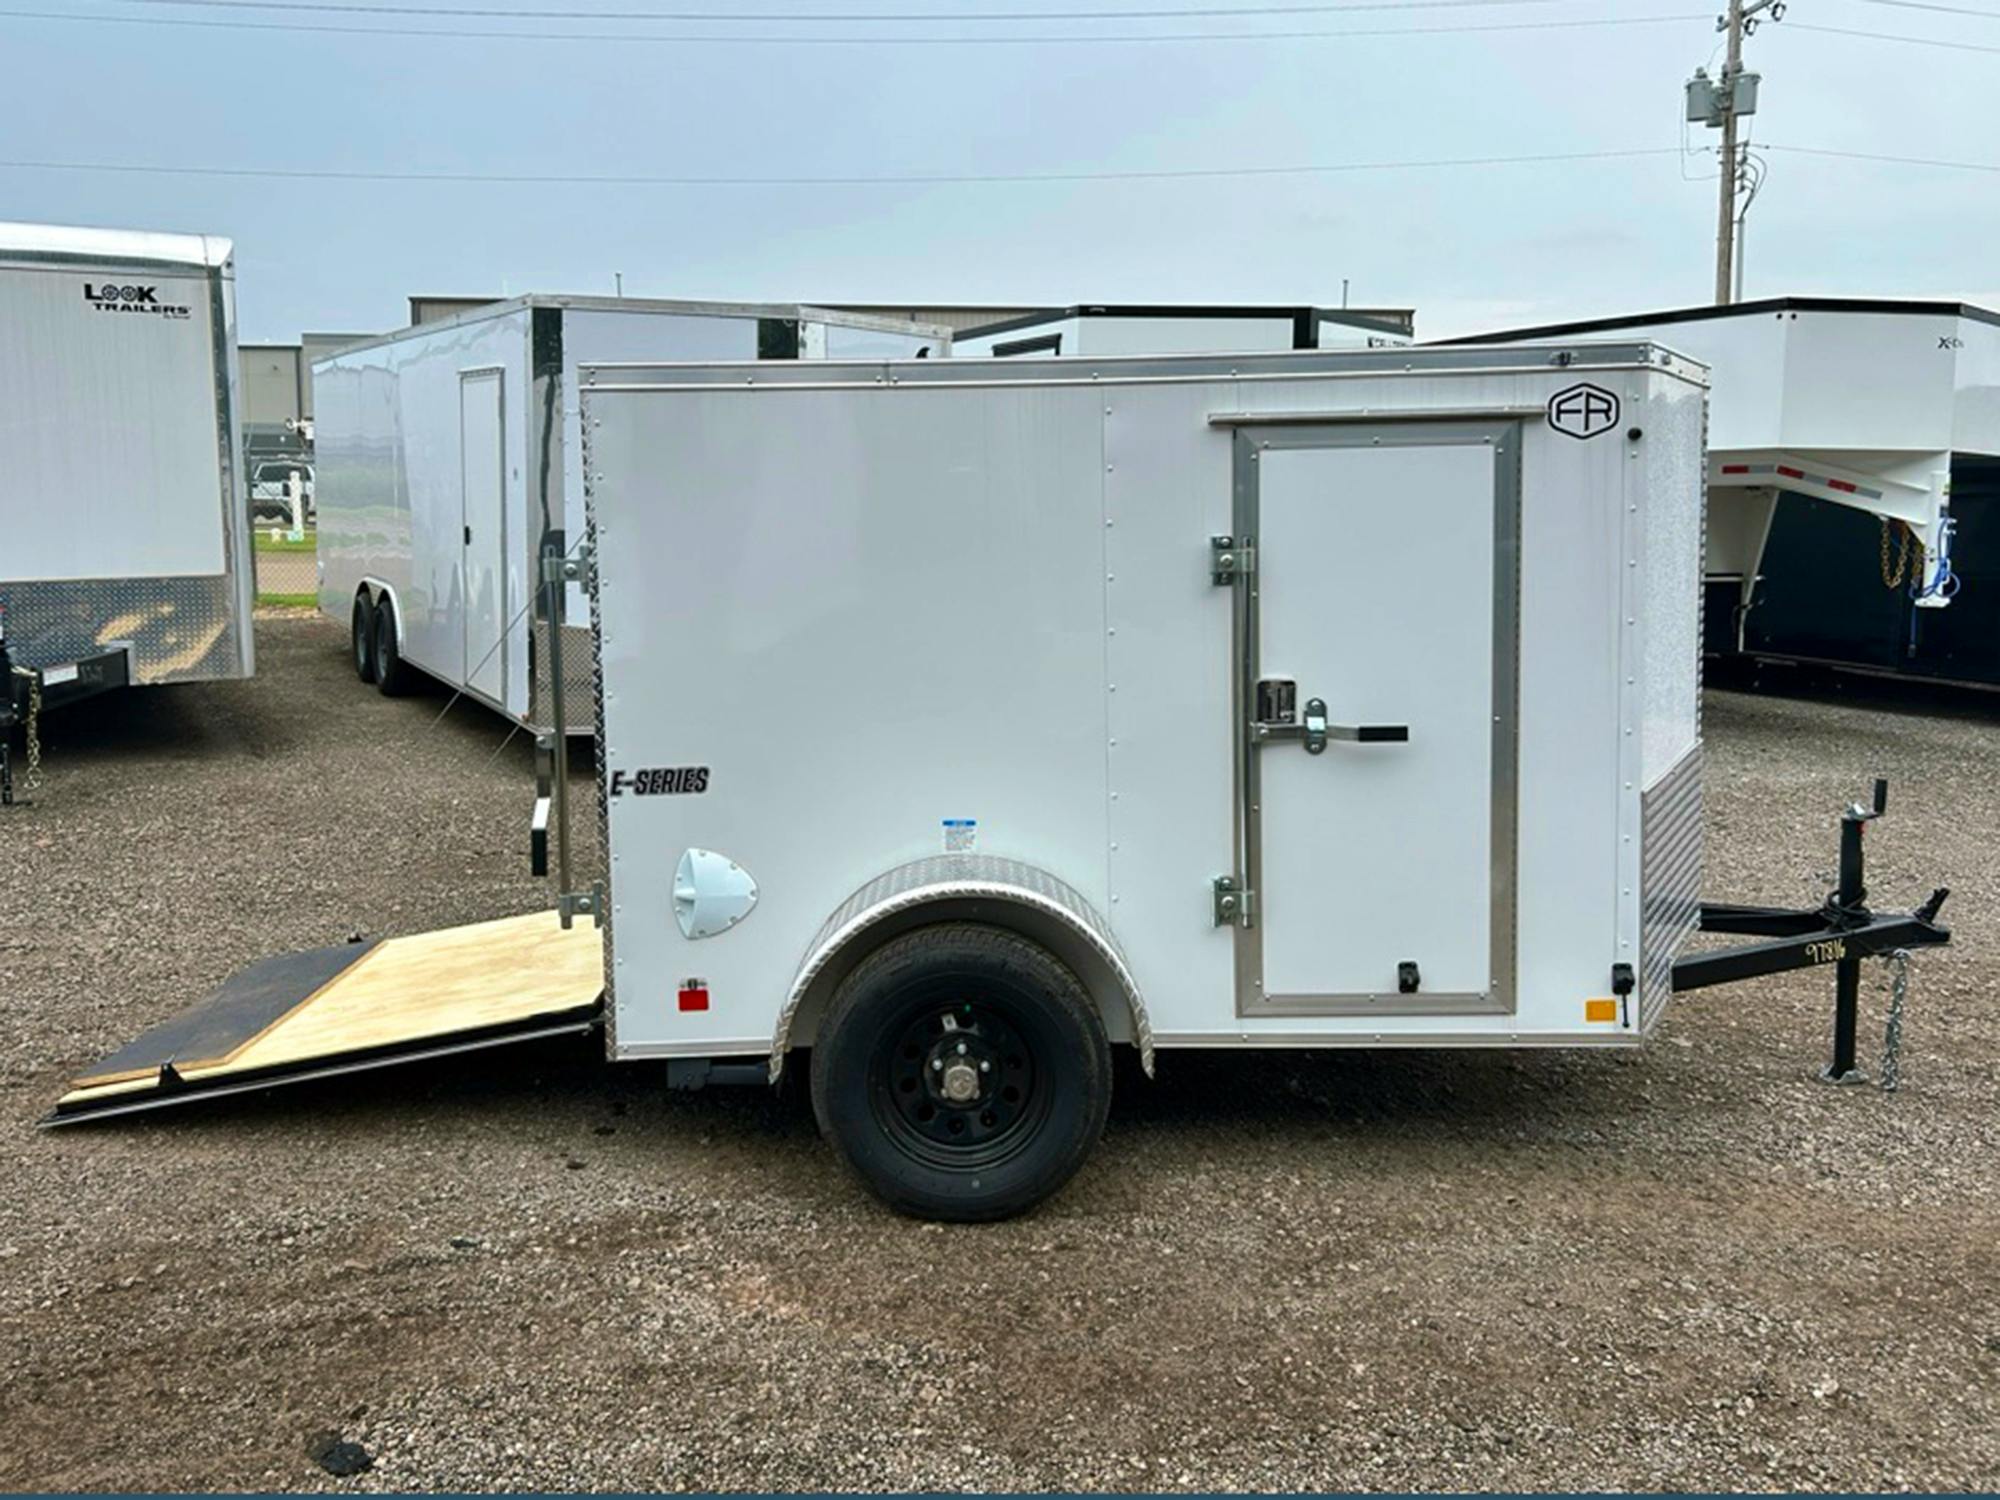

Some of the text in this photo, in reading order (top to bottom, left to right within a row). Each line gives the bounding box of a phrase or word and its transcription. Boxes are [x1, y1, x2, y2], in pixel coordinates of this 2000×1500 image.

[83, 283, 158, 304] LOOK
[93, 302, 189, 315] TRAILERS
[609, 766, 710, 797] E-SERIES
